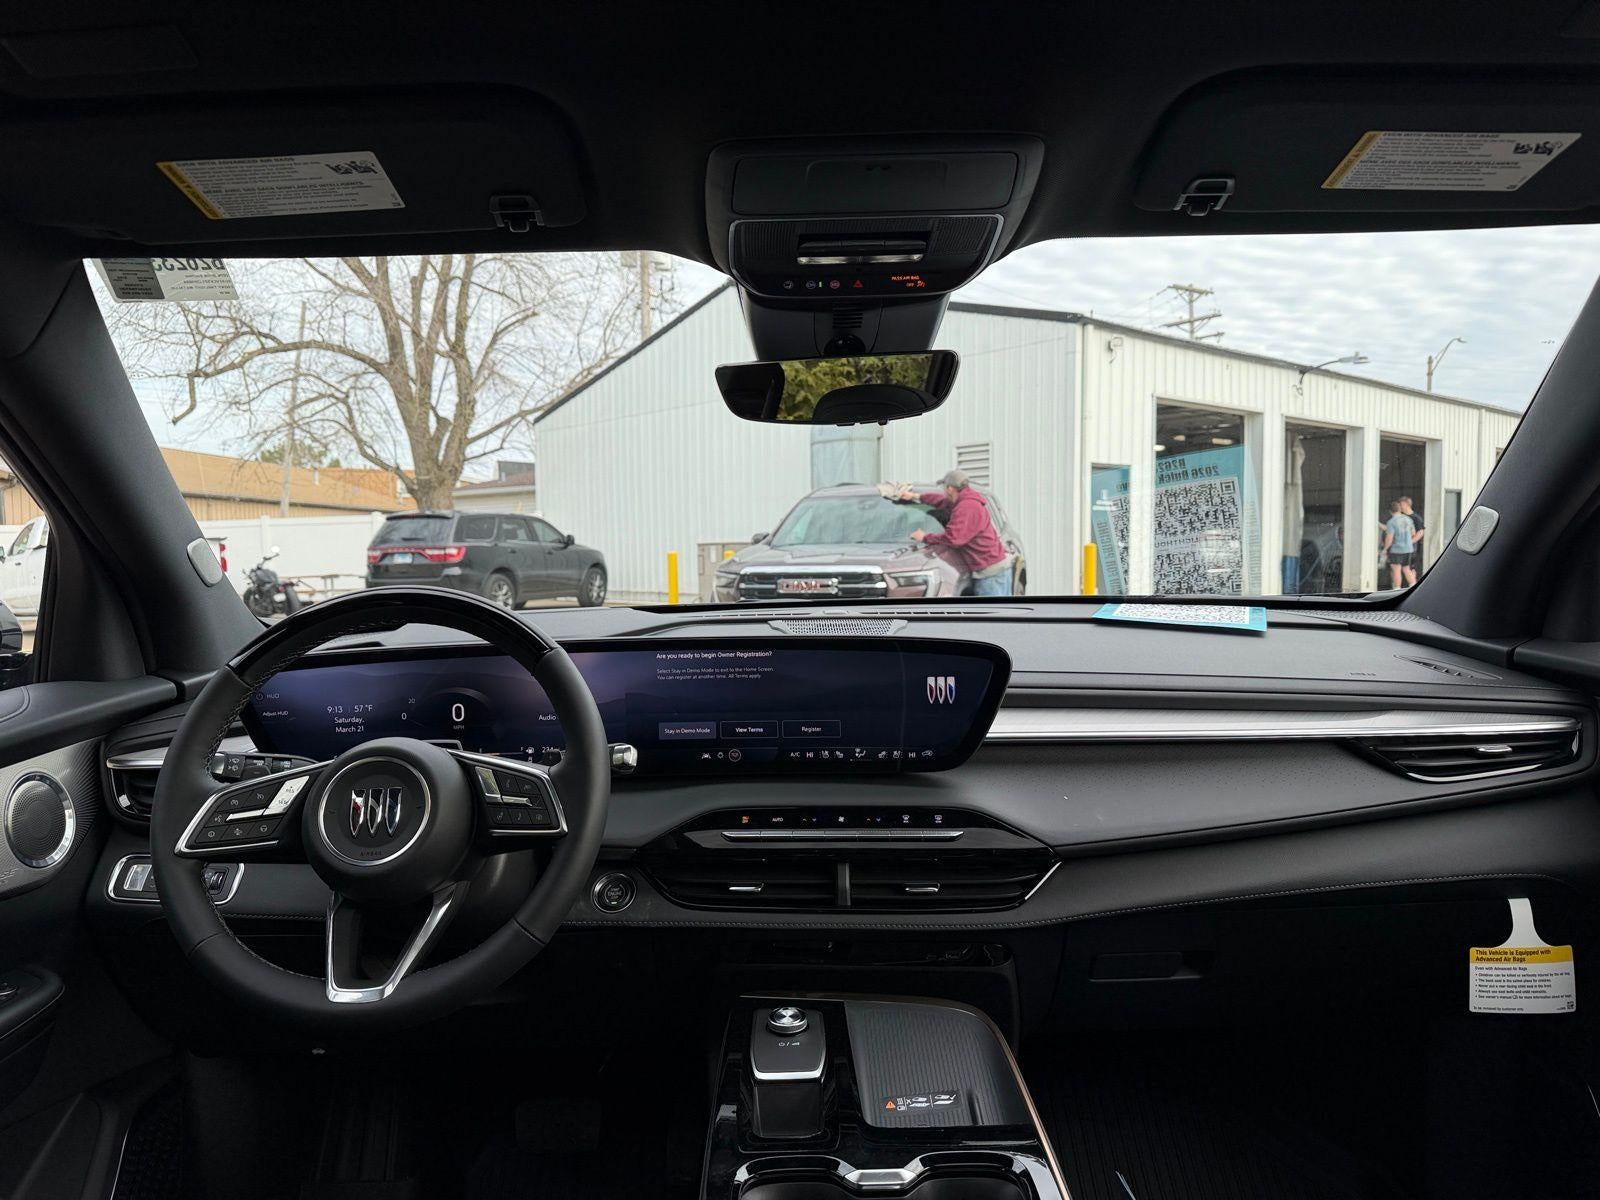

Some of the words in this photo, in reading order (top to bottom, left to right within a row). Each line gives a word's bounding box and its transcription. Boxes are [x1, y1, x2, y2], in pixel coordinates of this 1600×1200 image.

[401, 712, 407, 720] 0
[452, 703, 465, 721] 0
[1515, 949, 1539, 957] Equipped
